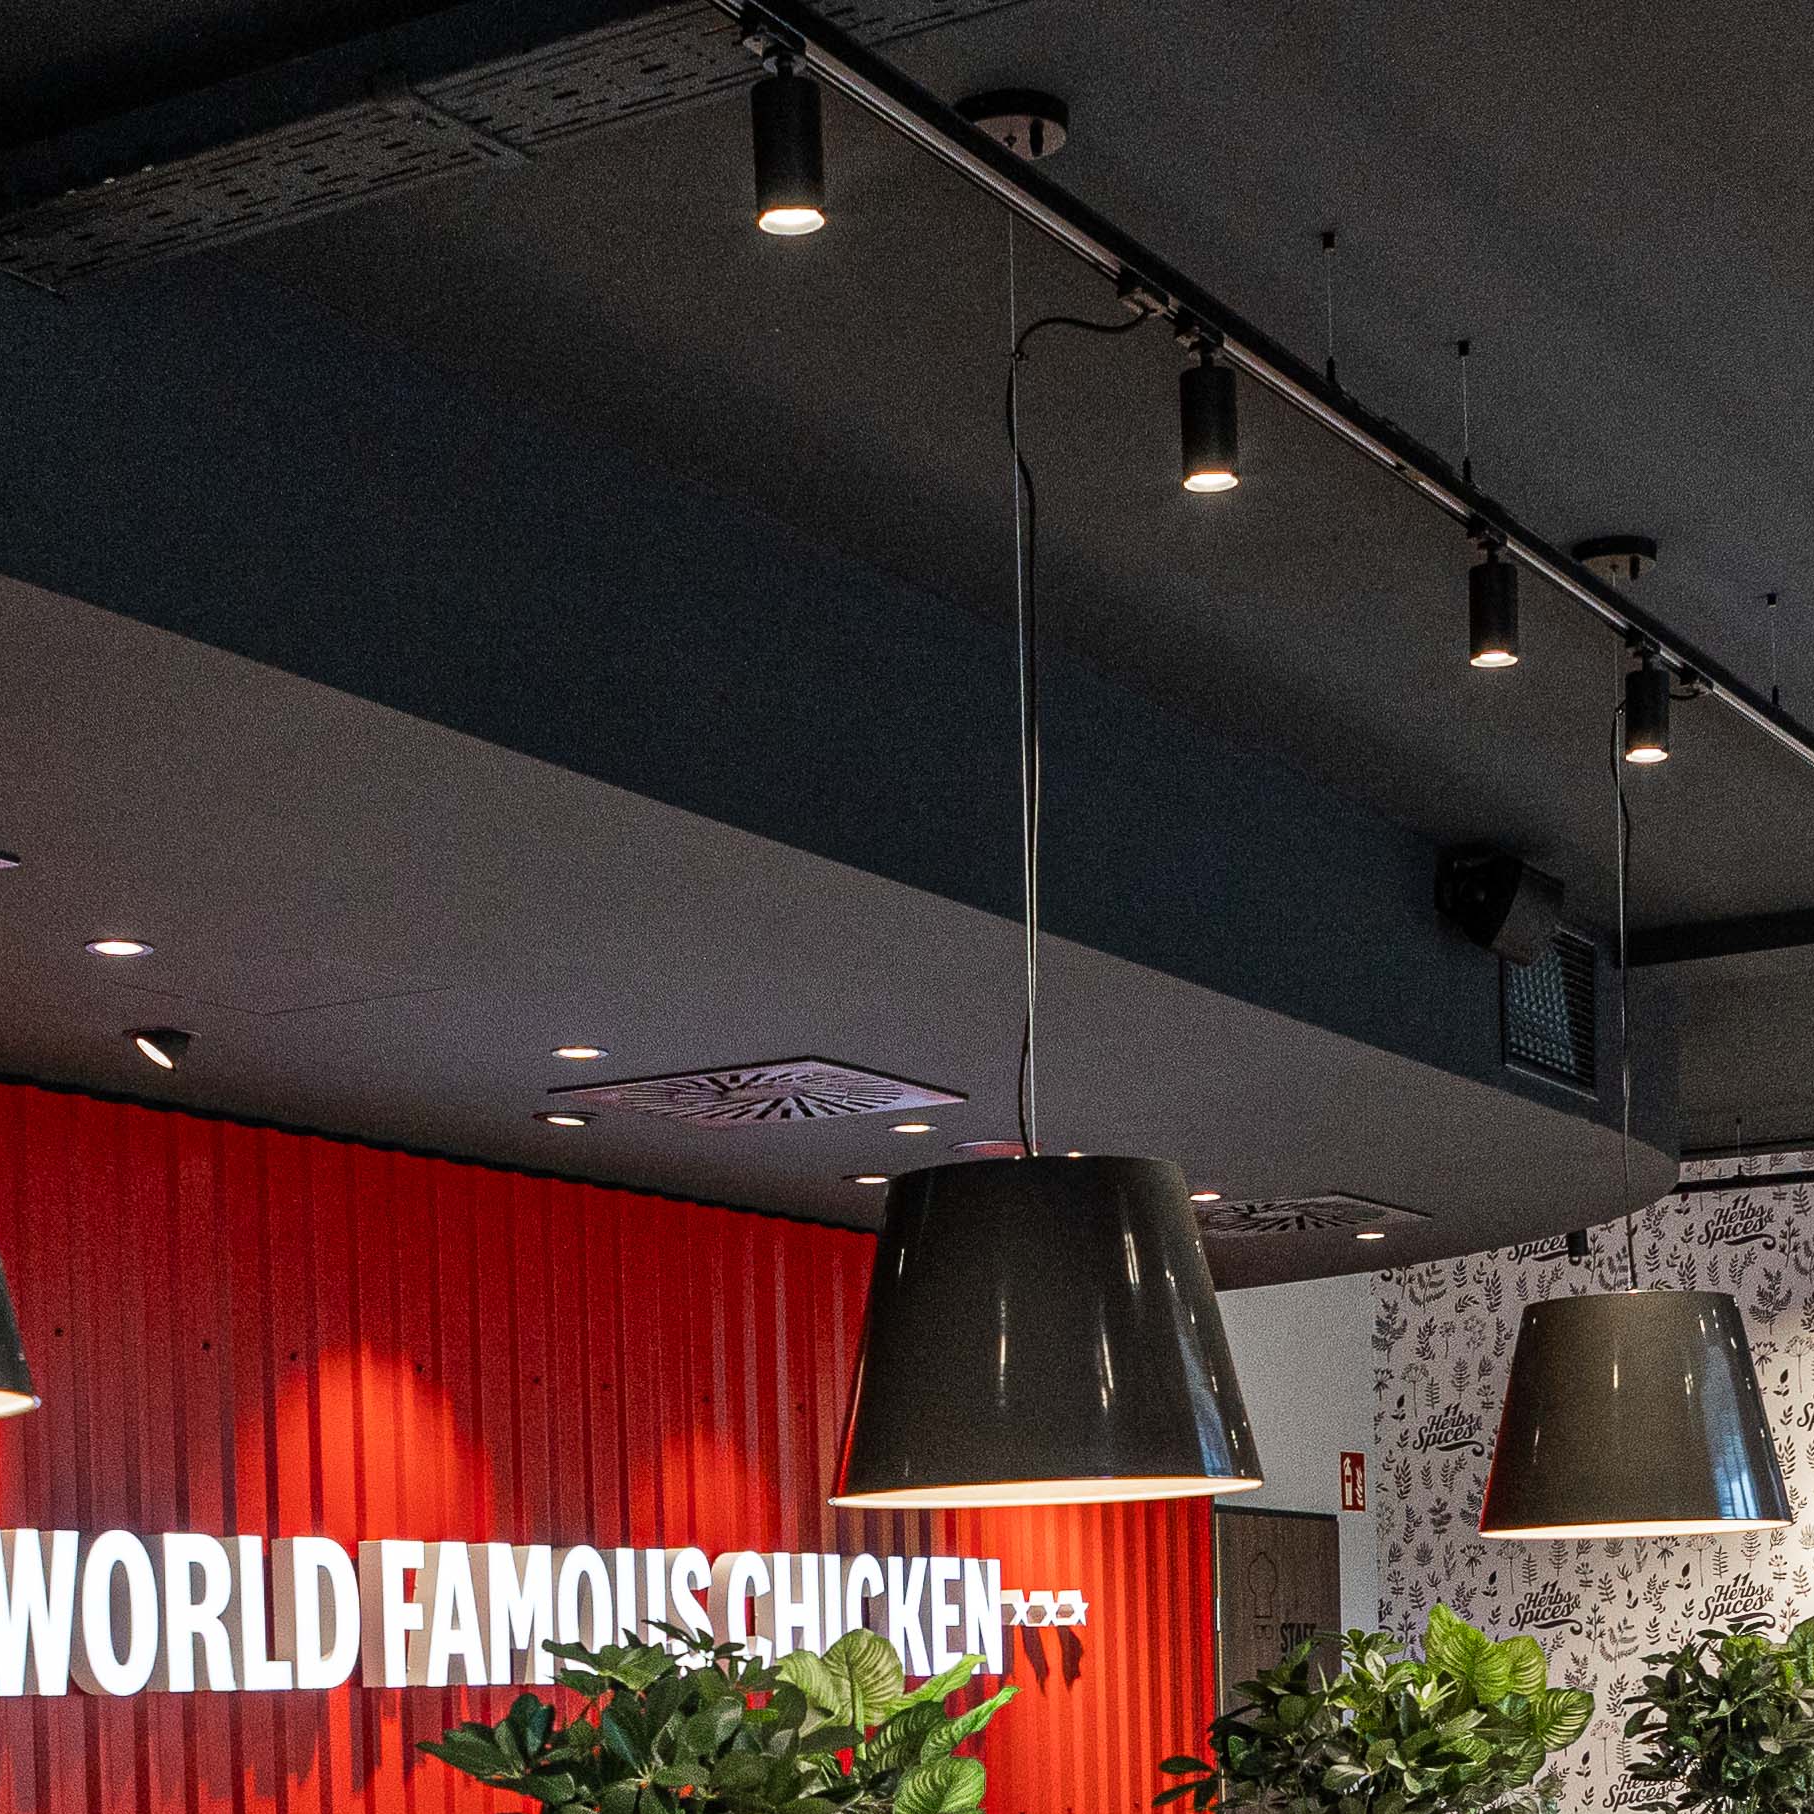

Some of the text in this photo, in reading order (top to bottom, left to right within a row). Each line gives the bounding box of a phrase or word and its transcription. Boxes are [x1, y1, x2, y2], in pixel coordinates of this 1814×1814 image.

[1732, 1194, 1750, 1210] 11
[1714, 1202, 1775, 1225] Herbs &
[1697, 1218, 1767, 1249] Spices
[1444, 1402, 1461, 1417] 11
[1427, 1410, 1474, 1432] Herbs
[1412, 1426, 1476, 1454] Spices
[1541, 1580, 1558, 1594] 11
[1732, 1572, 1750, 1587] 11
[1524, 1588, 1573, 1610] Herbs
[1715, 1581, 1774, 1603] Herbs &
[381, 1539, 712, 1688] FAMOUS
[727, 1550, 1003, 1676] CHICKEN
[1509, 1603, 1575, 1631] Spices
[1698, 1596, 1766, 1625] Spices
[1603, 1784, 1668, 1812] Spices
